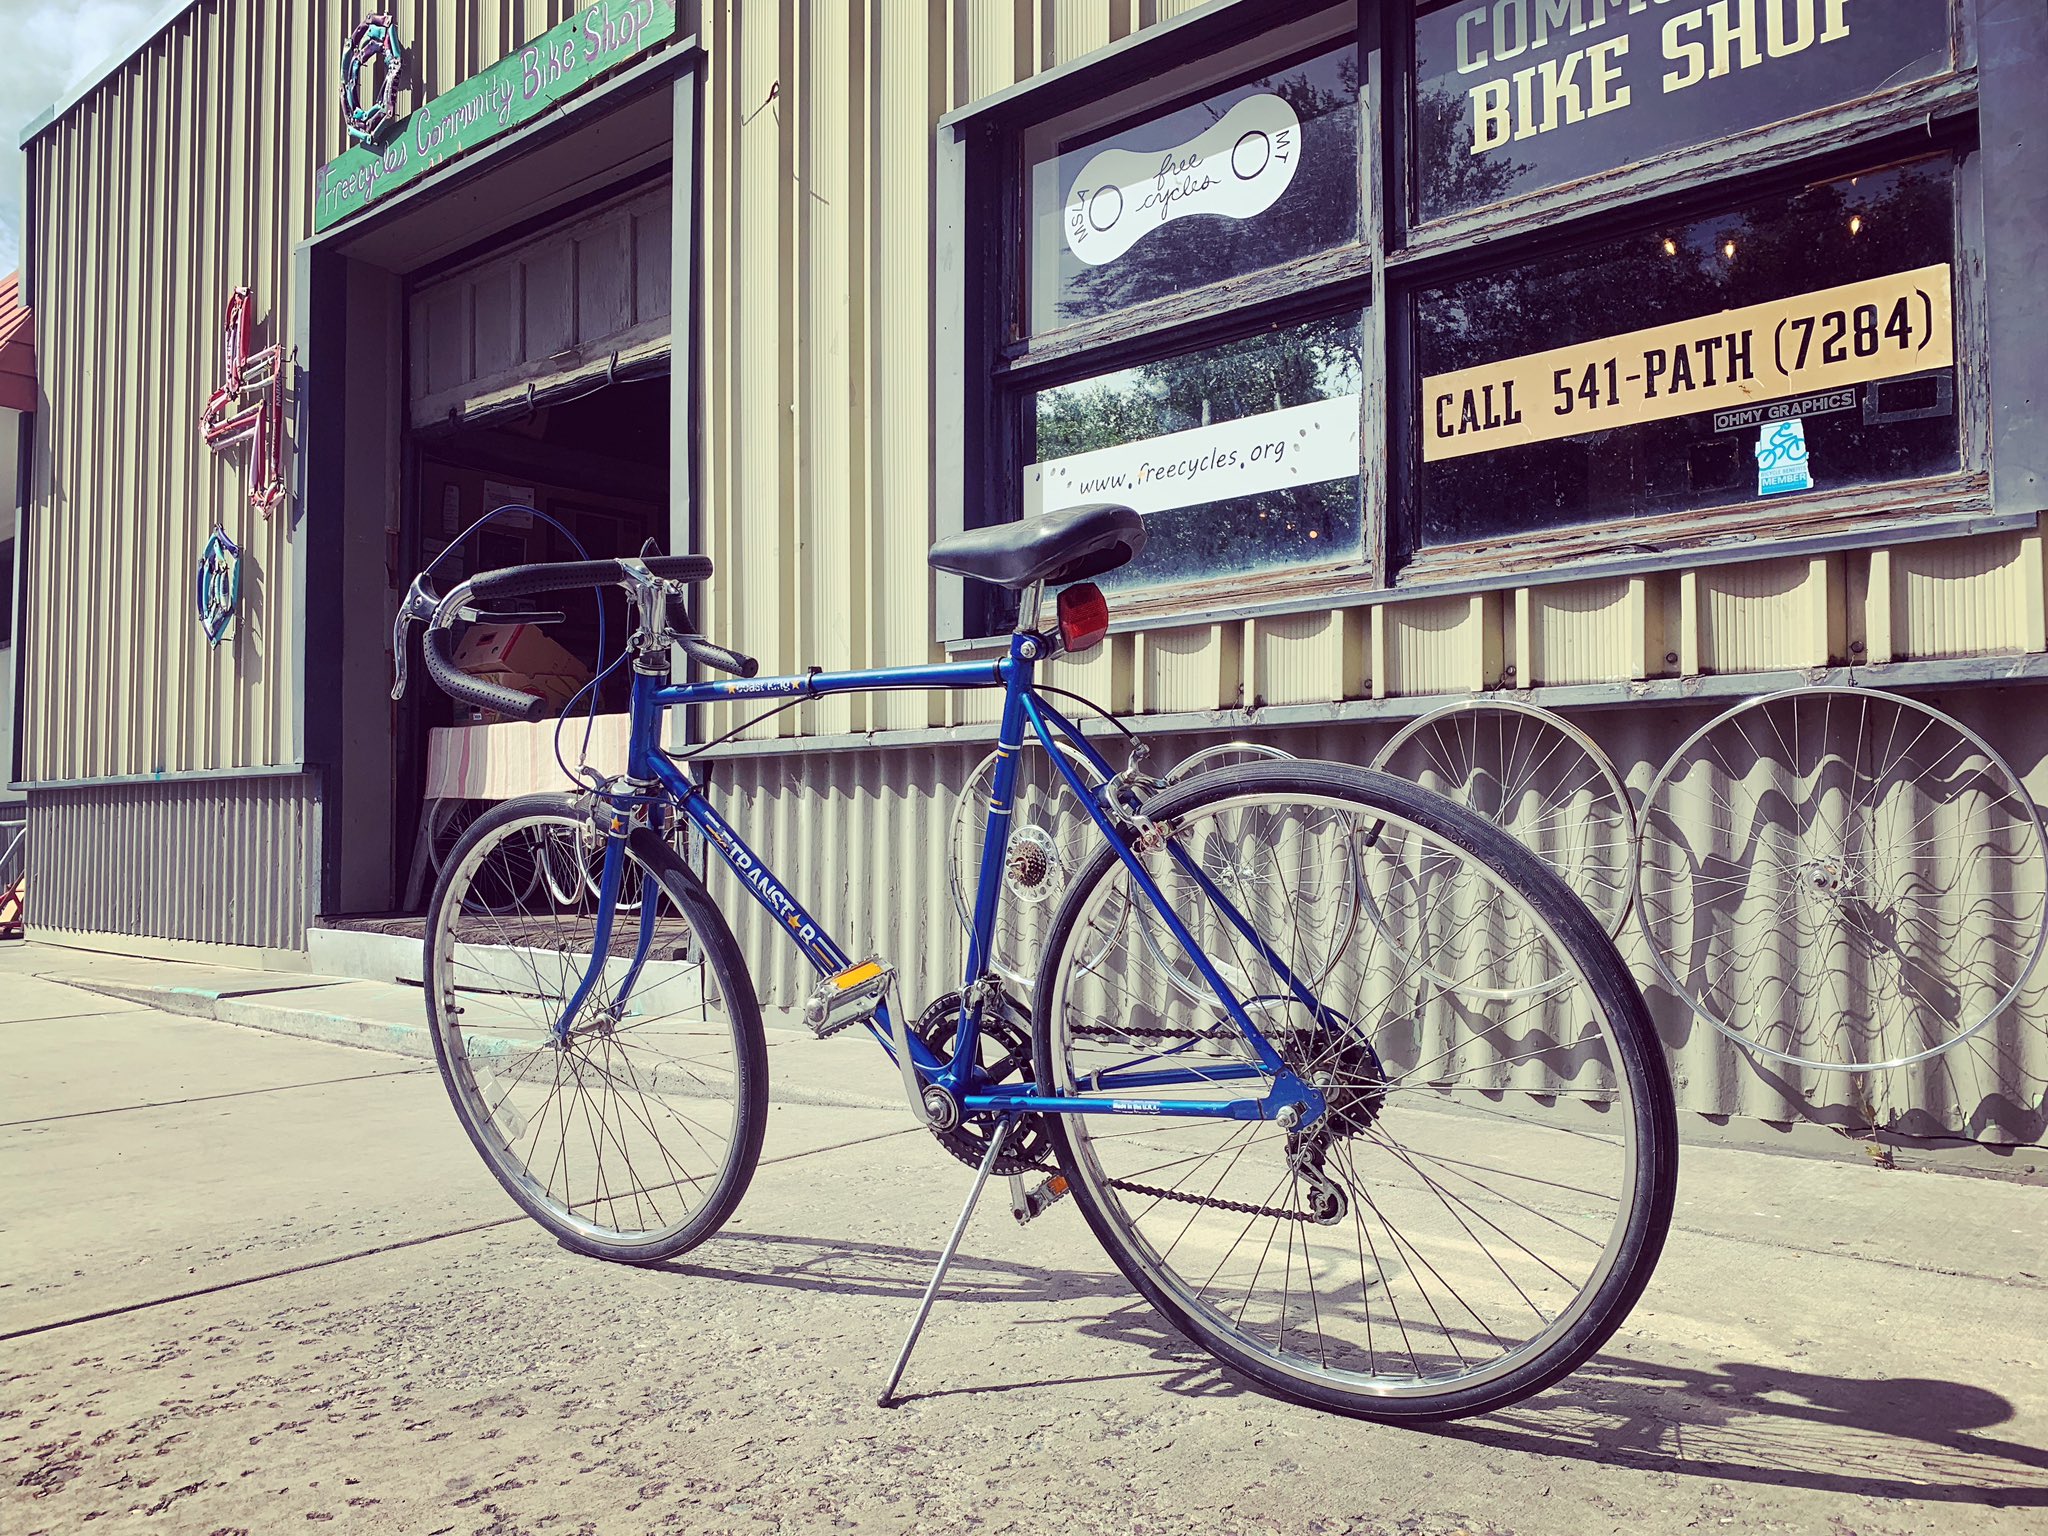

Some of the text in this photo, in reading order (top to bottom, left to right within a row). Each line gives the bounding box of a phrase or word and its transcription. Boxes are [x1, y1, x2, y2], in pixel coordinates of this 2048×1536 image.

[324, 0, 654, 217] Freecycles Community Bike Shop
[1469, 34, 1632, 155] BIKE
[1152, 153, 1204, 190] free
[1274, 129, 1290, 164] MT
[1071, 188, 1090, 244] MSLA
[1135, 174, 1222, 221] cycles
[1435, 286, 1933, 438] CALL 541-PATH (7284)
[1717, 392, 1852, 428] OHMY GRAPHICS
[1079, 438, 1286, 495] www.freecycles.org
[1762, 473, 1806, 487] MEMBER
